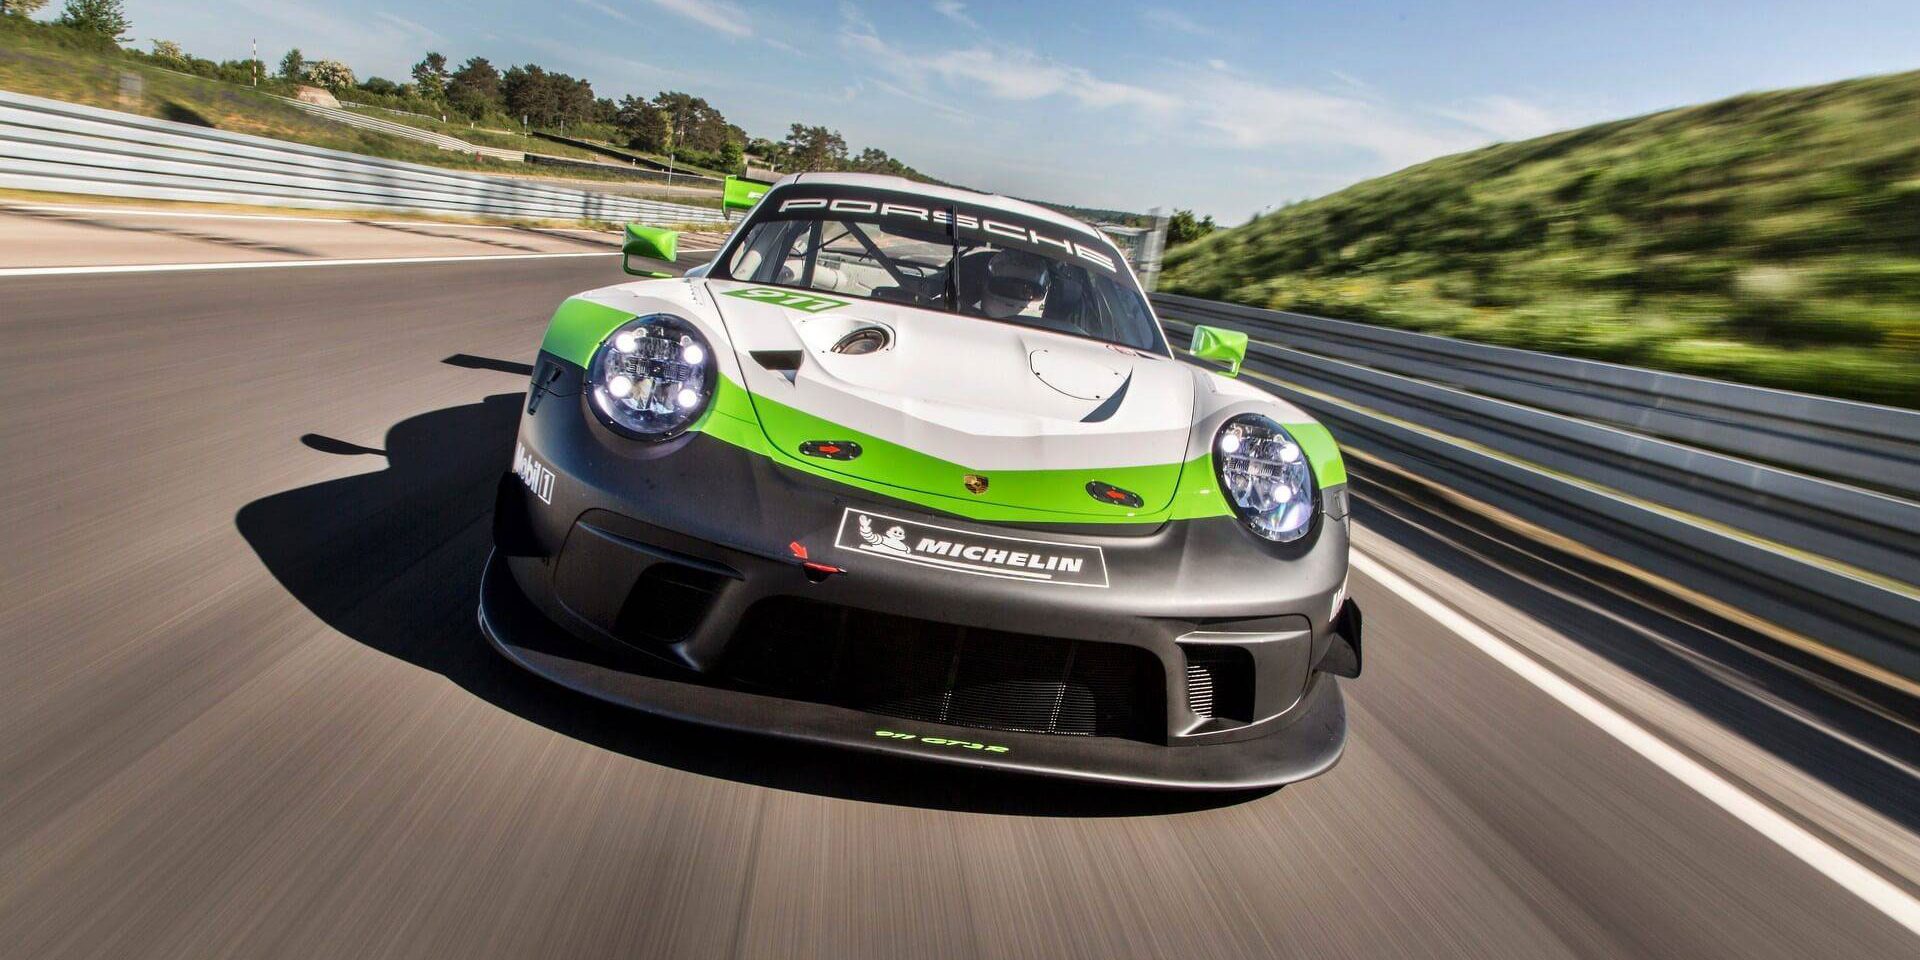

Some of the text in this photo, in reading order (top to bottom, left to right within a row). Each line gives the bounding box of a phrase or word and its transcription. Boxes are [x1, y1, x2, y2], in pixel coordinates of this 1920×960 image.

[778, 199, 1116, 273] PORSCHE
[740, 288, 840, 311] 911
[915, 538, 1083, 572] MICHELIN
[875, 731, 916, 740] 911
